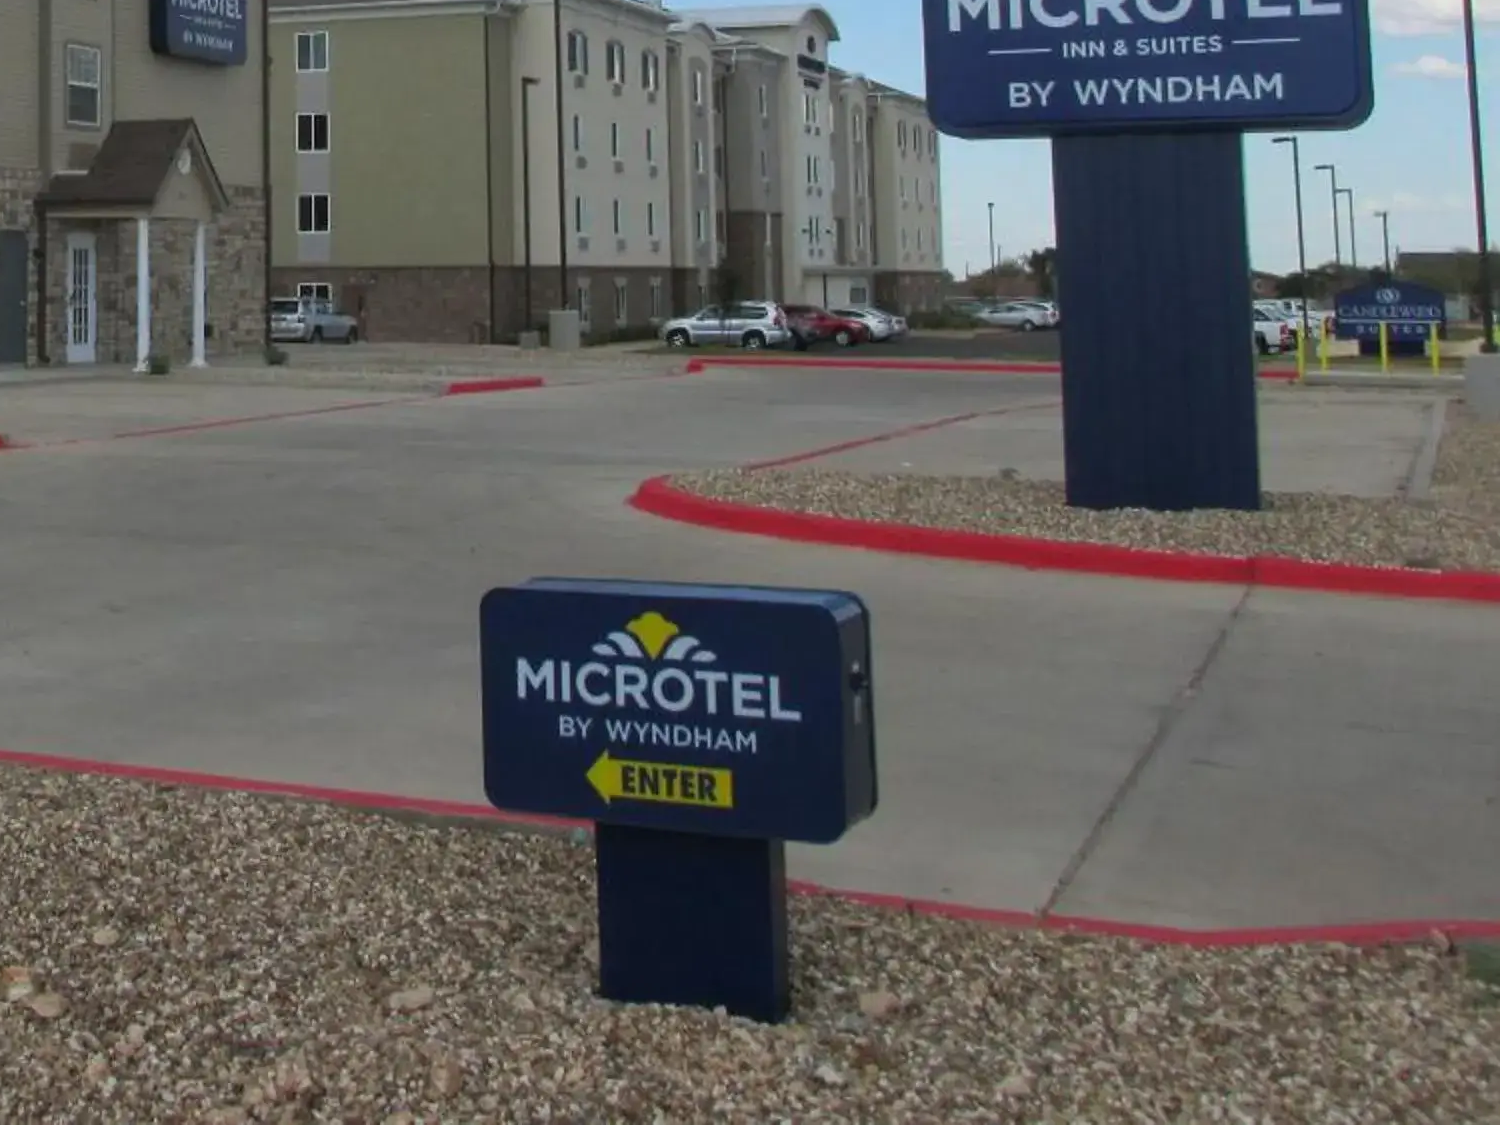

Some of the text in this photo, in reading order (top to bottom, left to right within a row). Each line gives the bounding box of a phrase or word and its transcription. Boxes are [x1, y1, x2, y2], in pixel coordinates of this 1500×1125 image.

[1062, 34, 1224, 59] INN & SUITES
[1008, 73, 1284, 109] BY WYNDHAM
[516, 657, 803, 722] MICROTEL
[558, 715, 758, 755] BY WYNDHAM
[621, 765, 718, 803] ENTER
